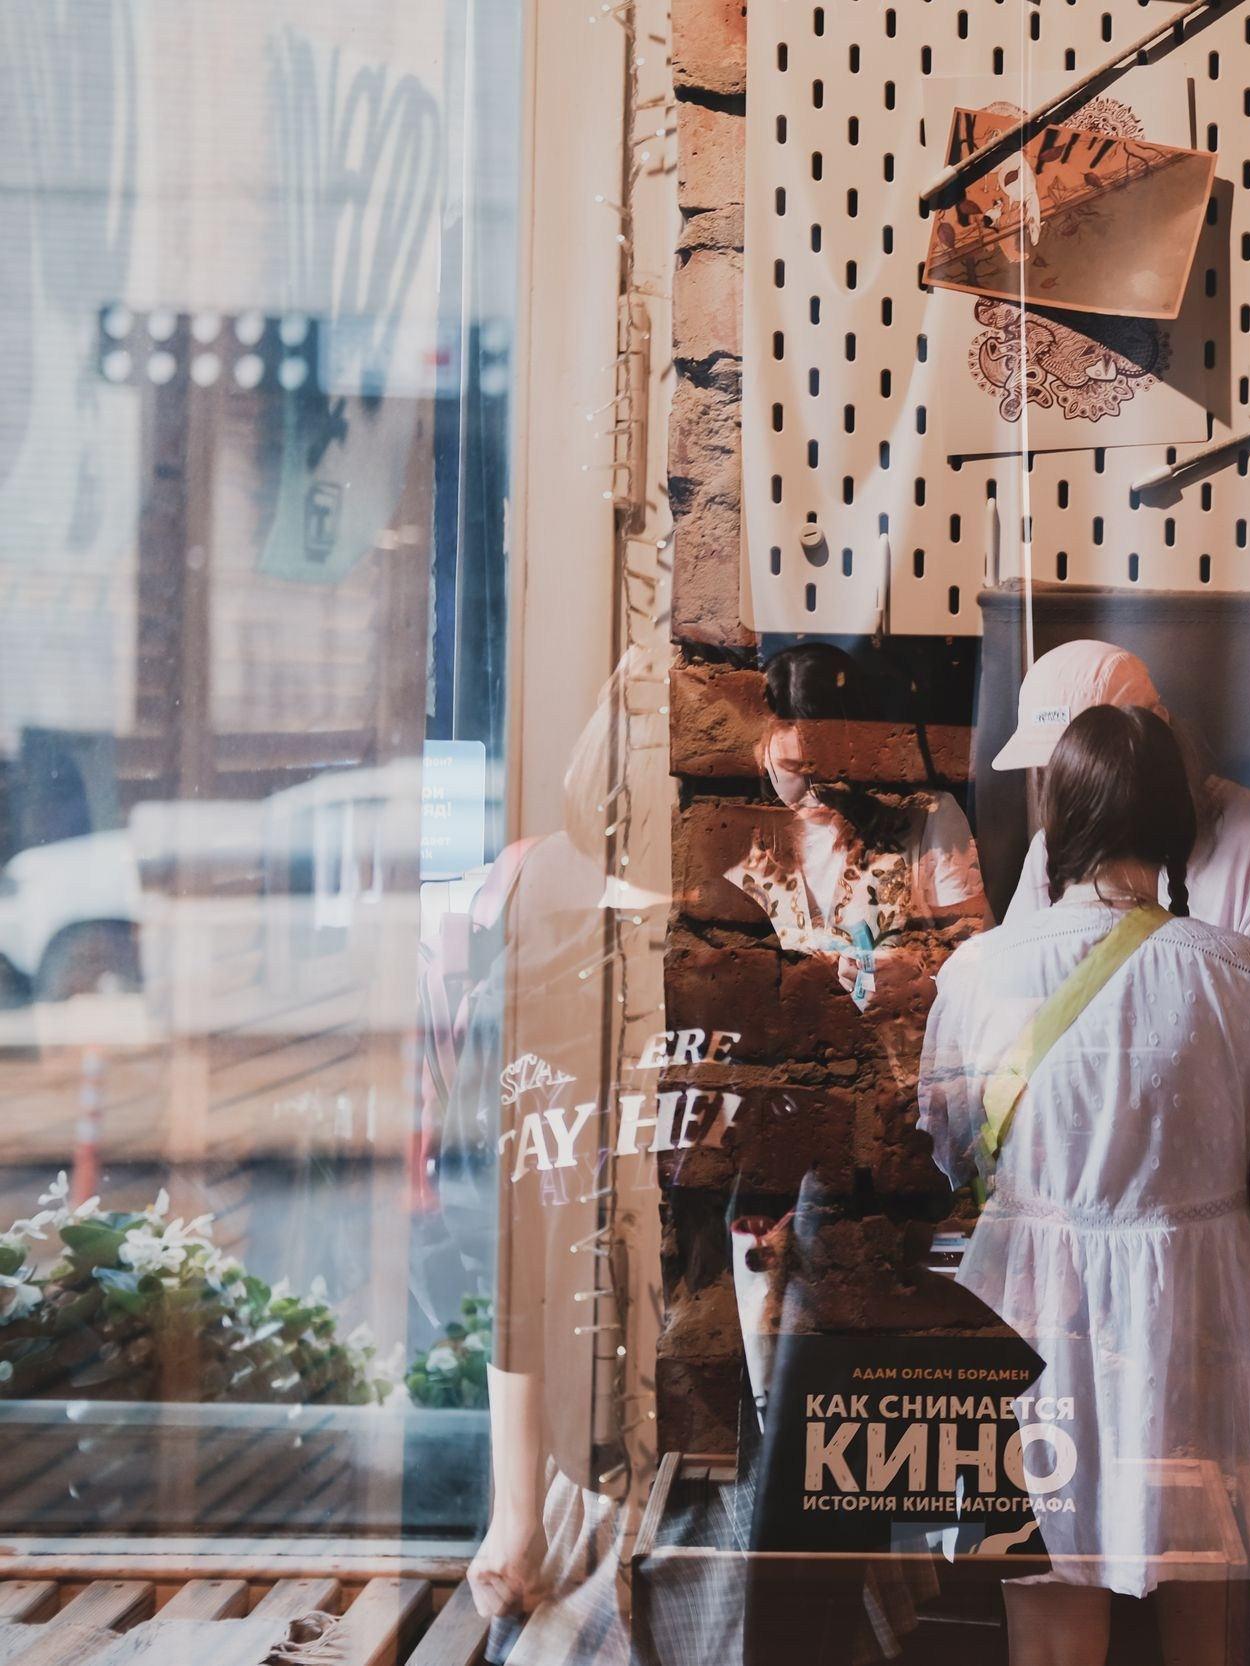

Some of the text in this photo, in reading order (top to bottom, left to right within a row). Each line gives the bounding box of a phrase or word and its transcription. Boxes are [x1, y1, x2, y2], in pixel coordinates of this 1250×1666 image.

[500, 1028, 741, 1105] STA ERE
[498, 1102, 597, 1183] AY
[852, 1368, 1029, 1381] АДАМ ОЛСАЧ БОРДМЕН
[806, 1394, 1075, 1420] КАК СНИМАЕТСЯ
[804, 1422, 1077, 1494] КИНО
[803, 1496, 1076, 1513] ИСТОРИЯ КИНЕМАТОГРАФА
